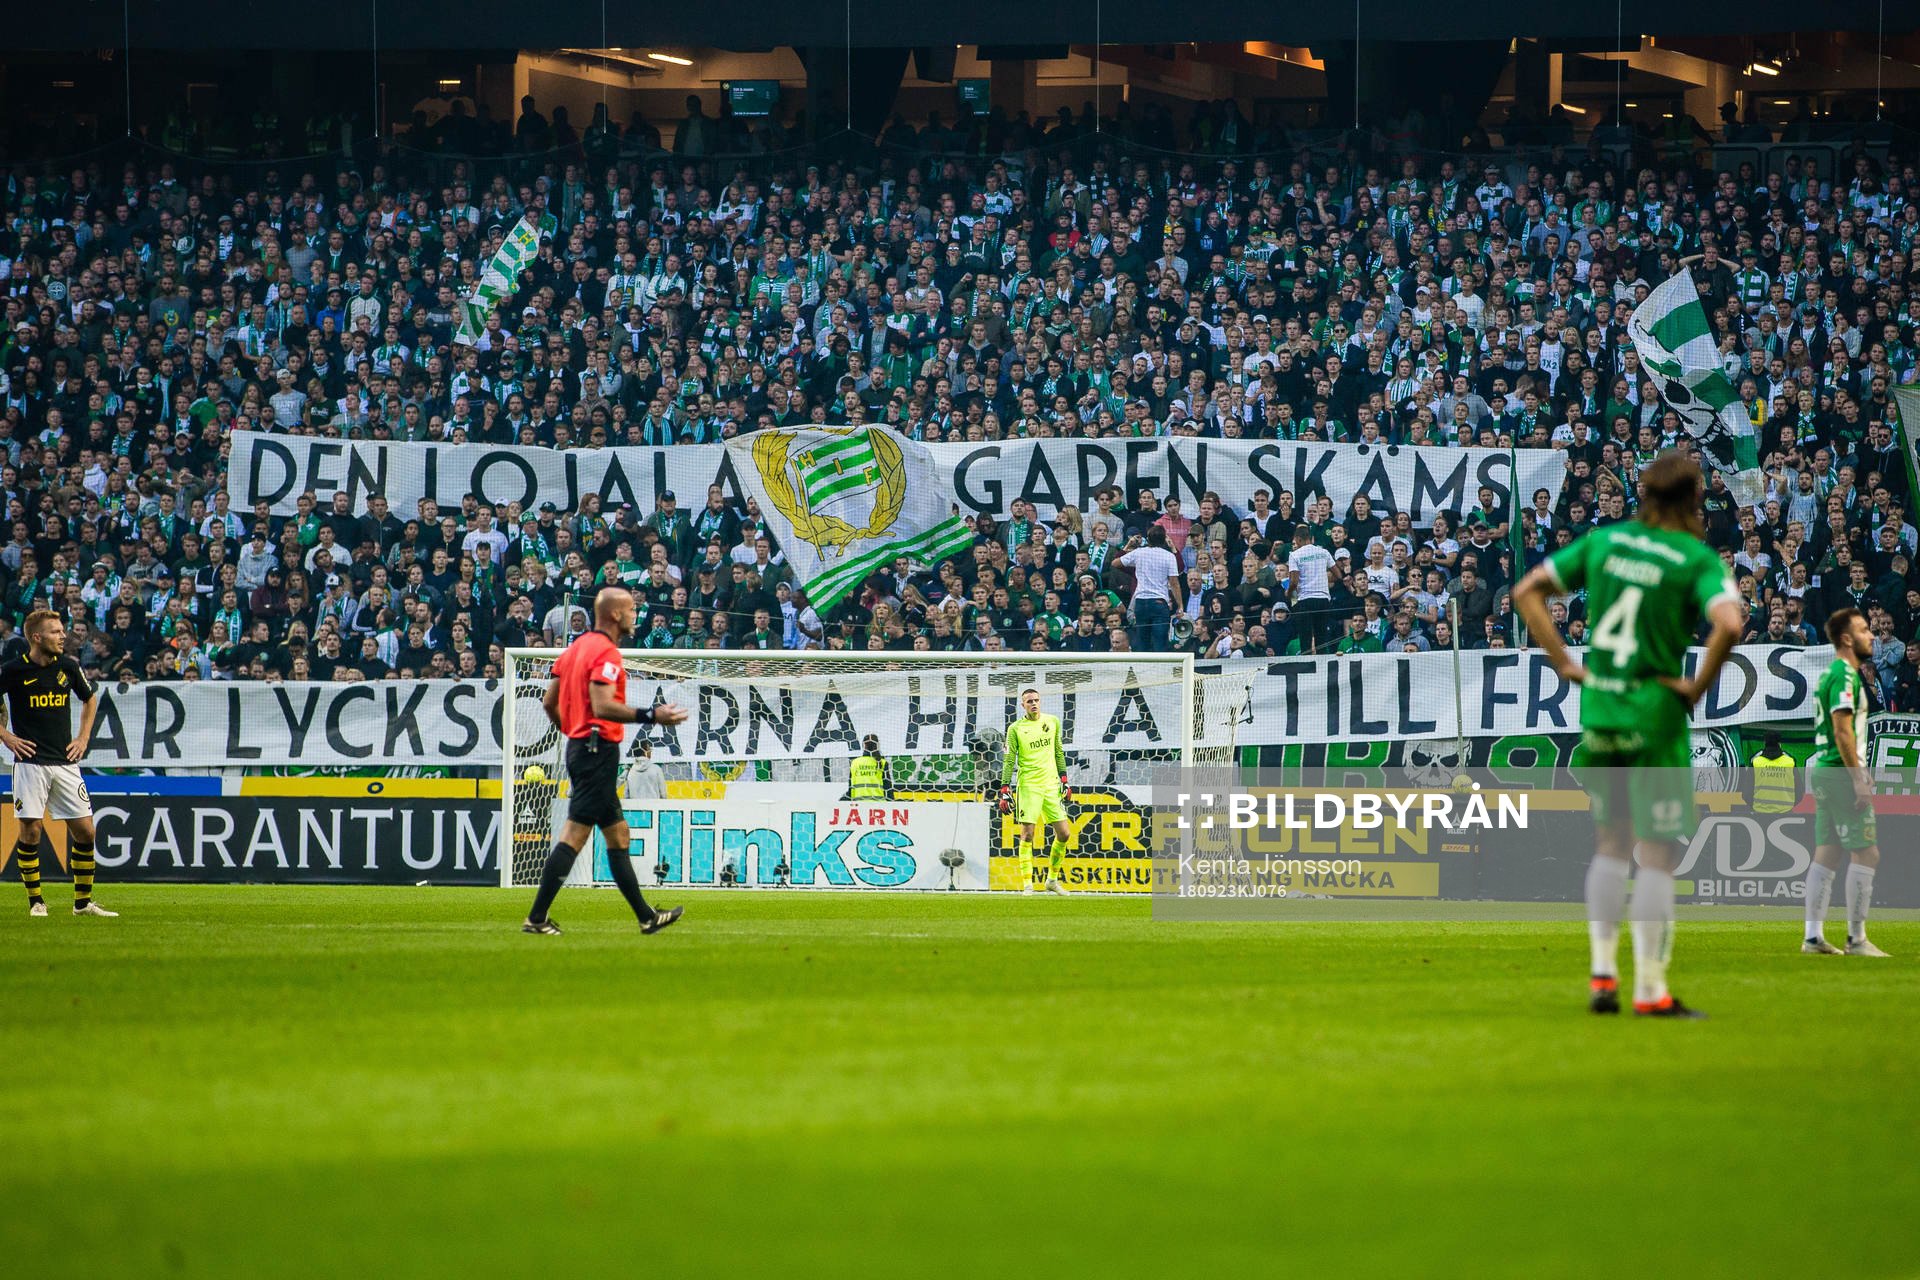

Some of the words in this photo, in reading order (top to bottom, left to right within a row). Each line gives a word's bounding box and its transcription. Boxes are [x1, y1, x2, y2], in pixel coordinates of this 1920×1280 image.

[248, 439, 387, 512] DEN
[425, 447, 749, 519] LOJALA
[1248, 443, 1511, 521] SKÄMS
[1591, 585, 1643, 668] 4
[30, 690, 68, 708] notar
[84, 681, 186, 759] ÄR
[226, 678, 861, 758] LYCKSÖARNA
[1267, 658, 1436, 737] TILL
[1481, 647, 1807, 729] FRDS
[1030, 738, 1051, 749] notar
[829, 803, 910, 826] JÄRN
[94, 805, 501, 869] GARANTUM
[593, 809, 917, 887] Flinks
[1303, 870, 1395, 889] NACKA
[1698, 880, 1807, 898] BILGLAS
